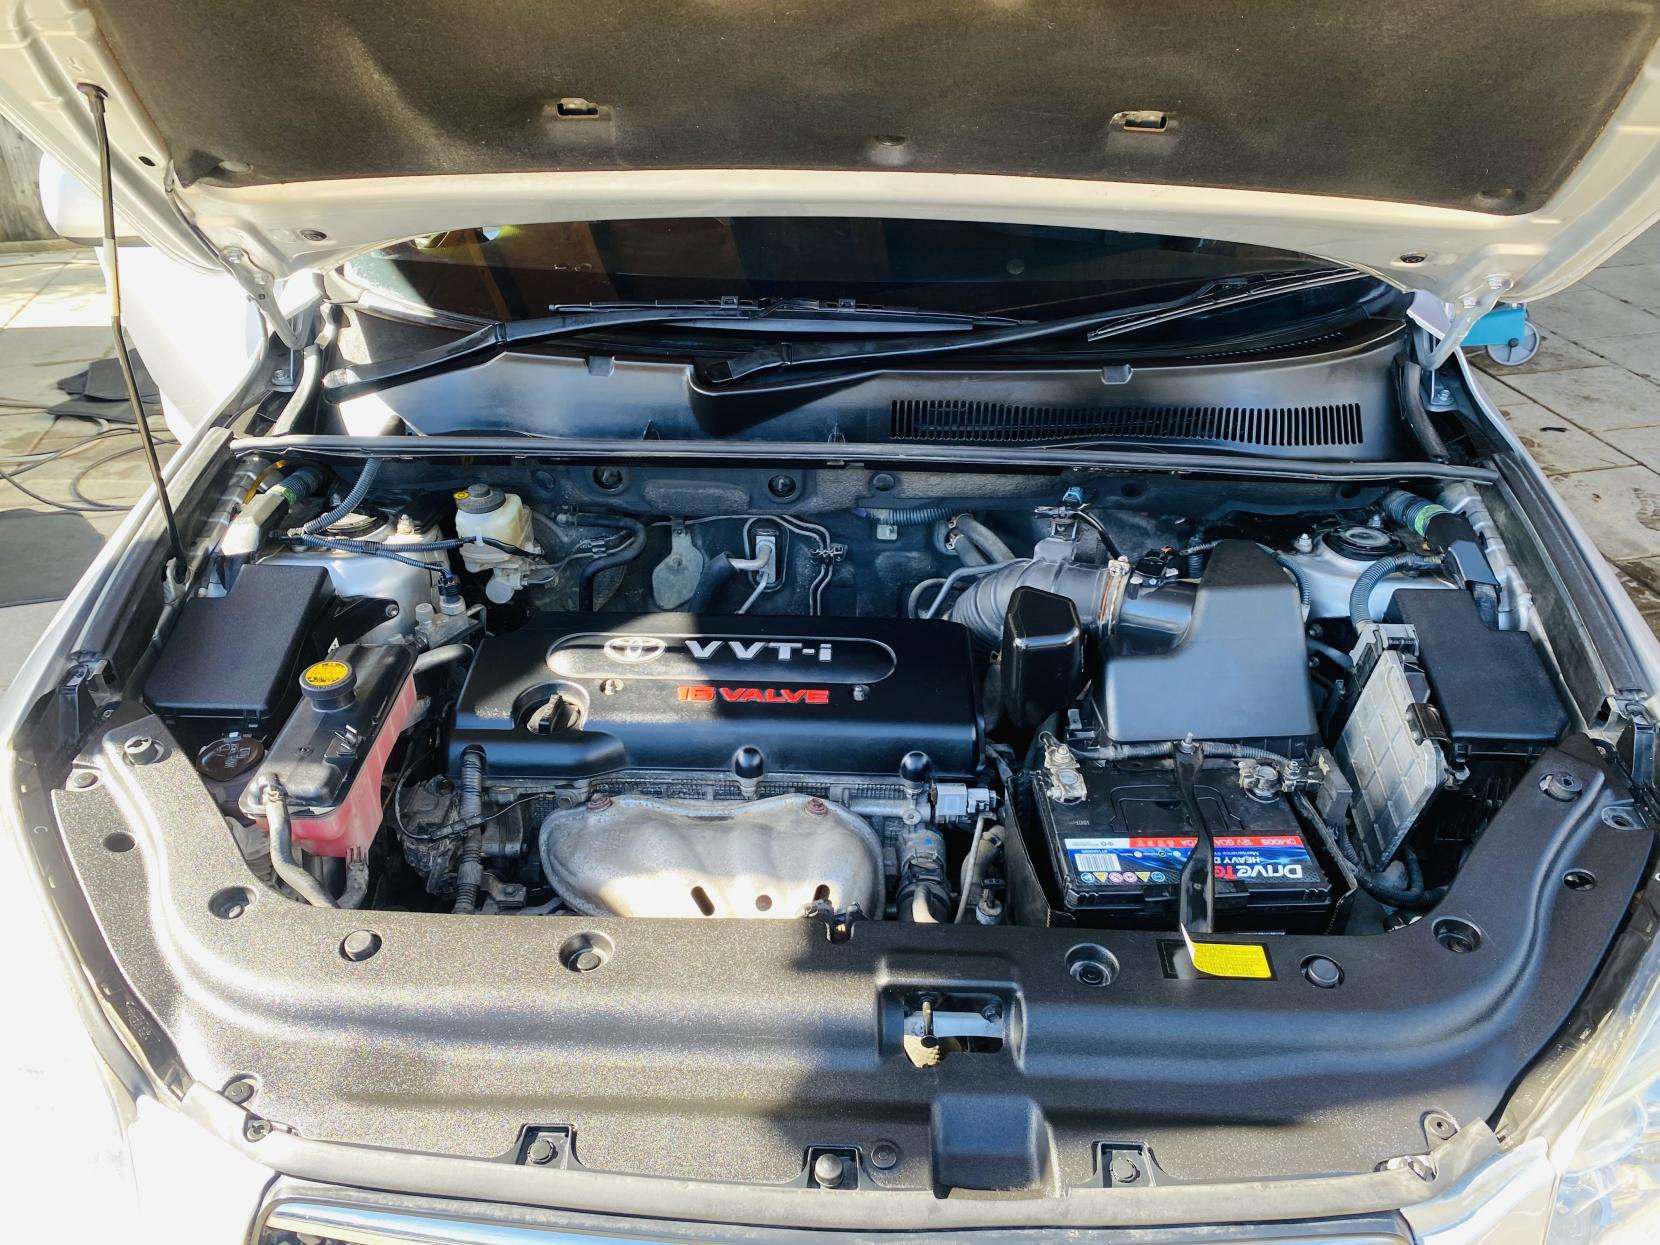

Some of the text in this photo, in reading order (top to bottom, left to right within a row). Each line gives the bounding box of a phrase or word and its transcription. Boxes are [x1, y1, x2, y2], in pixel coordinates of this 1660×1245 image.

[685, 640, 832, 662] VVT-i
[677, 684, 829, 704] 16 VALVE
[1223, 856, 1260, 864] HEAVY
[1214, 863, 1303, 882] DriveTe
